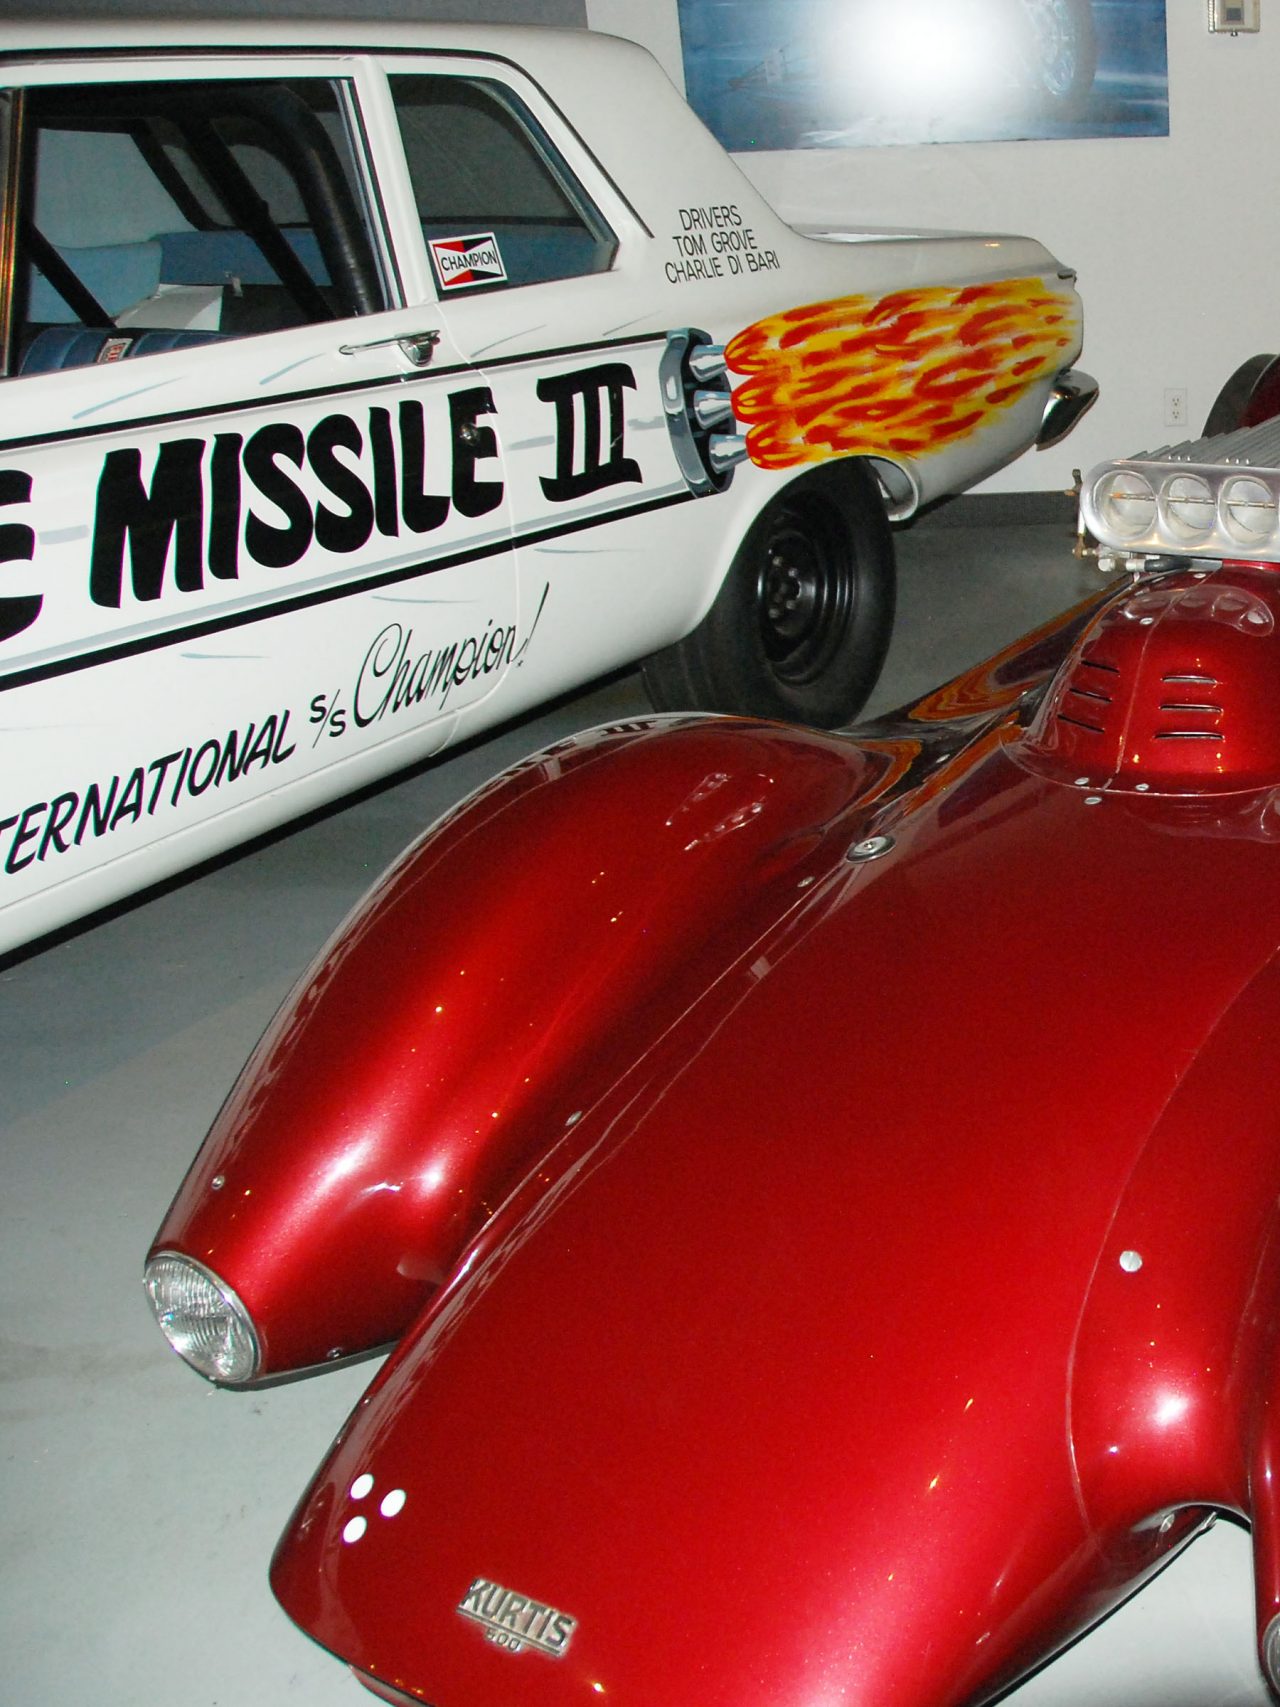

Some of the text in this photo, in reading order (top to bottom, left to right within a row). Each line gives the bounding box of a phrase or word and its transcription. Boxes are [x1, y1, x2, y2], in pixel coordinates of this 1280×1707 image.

[678, 204, 743, 231] DRIVERS
[440, 249, 498, 271] CHAMPION
[672, 229, 758, 257] TOM GROVE
[664, 250, 780, 284] CHARLIE DI BARI
[89, 386, 504, 609] MISSILE
[536, 362, 643, 502] III
[353, 581, 549, 729] Champion!
[460, 1577, 573, 1648] KURTIS
